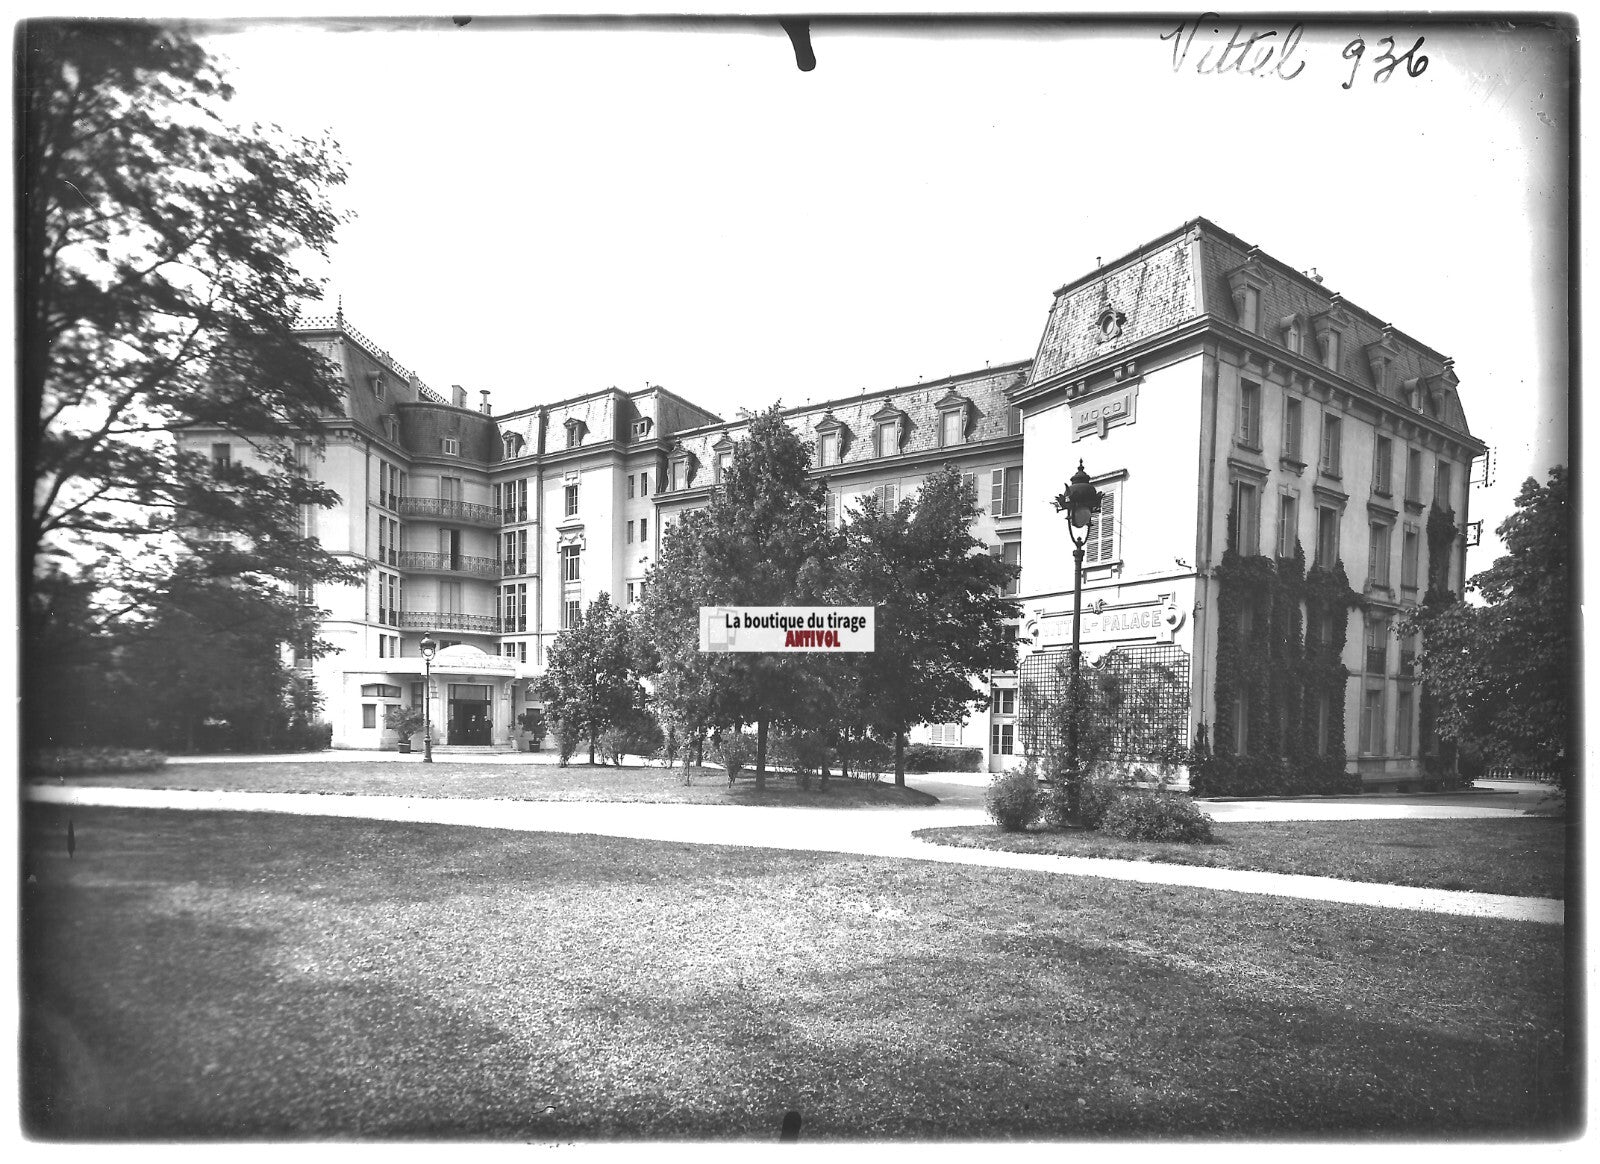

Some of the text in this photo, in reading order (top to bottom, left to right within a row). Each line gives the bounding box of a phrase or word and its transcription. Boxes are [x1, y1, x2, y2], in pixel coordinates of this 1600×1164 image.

[1160, 12, 1429, 89] Vittel 936
[1041, 610, 1162, 637] VITTL-PALACE
